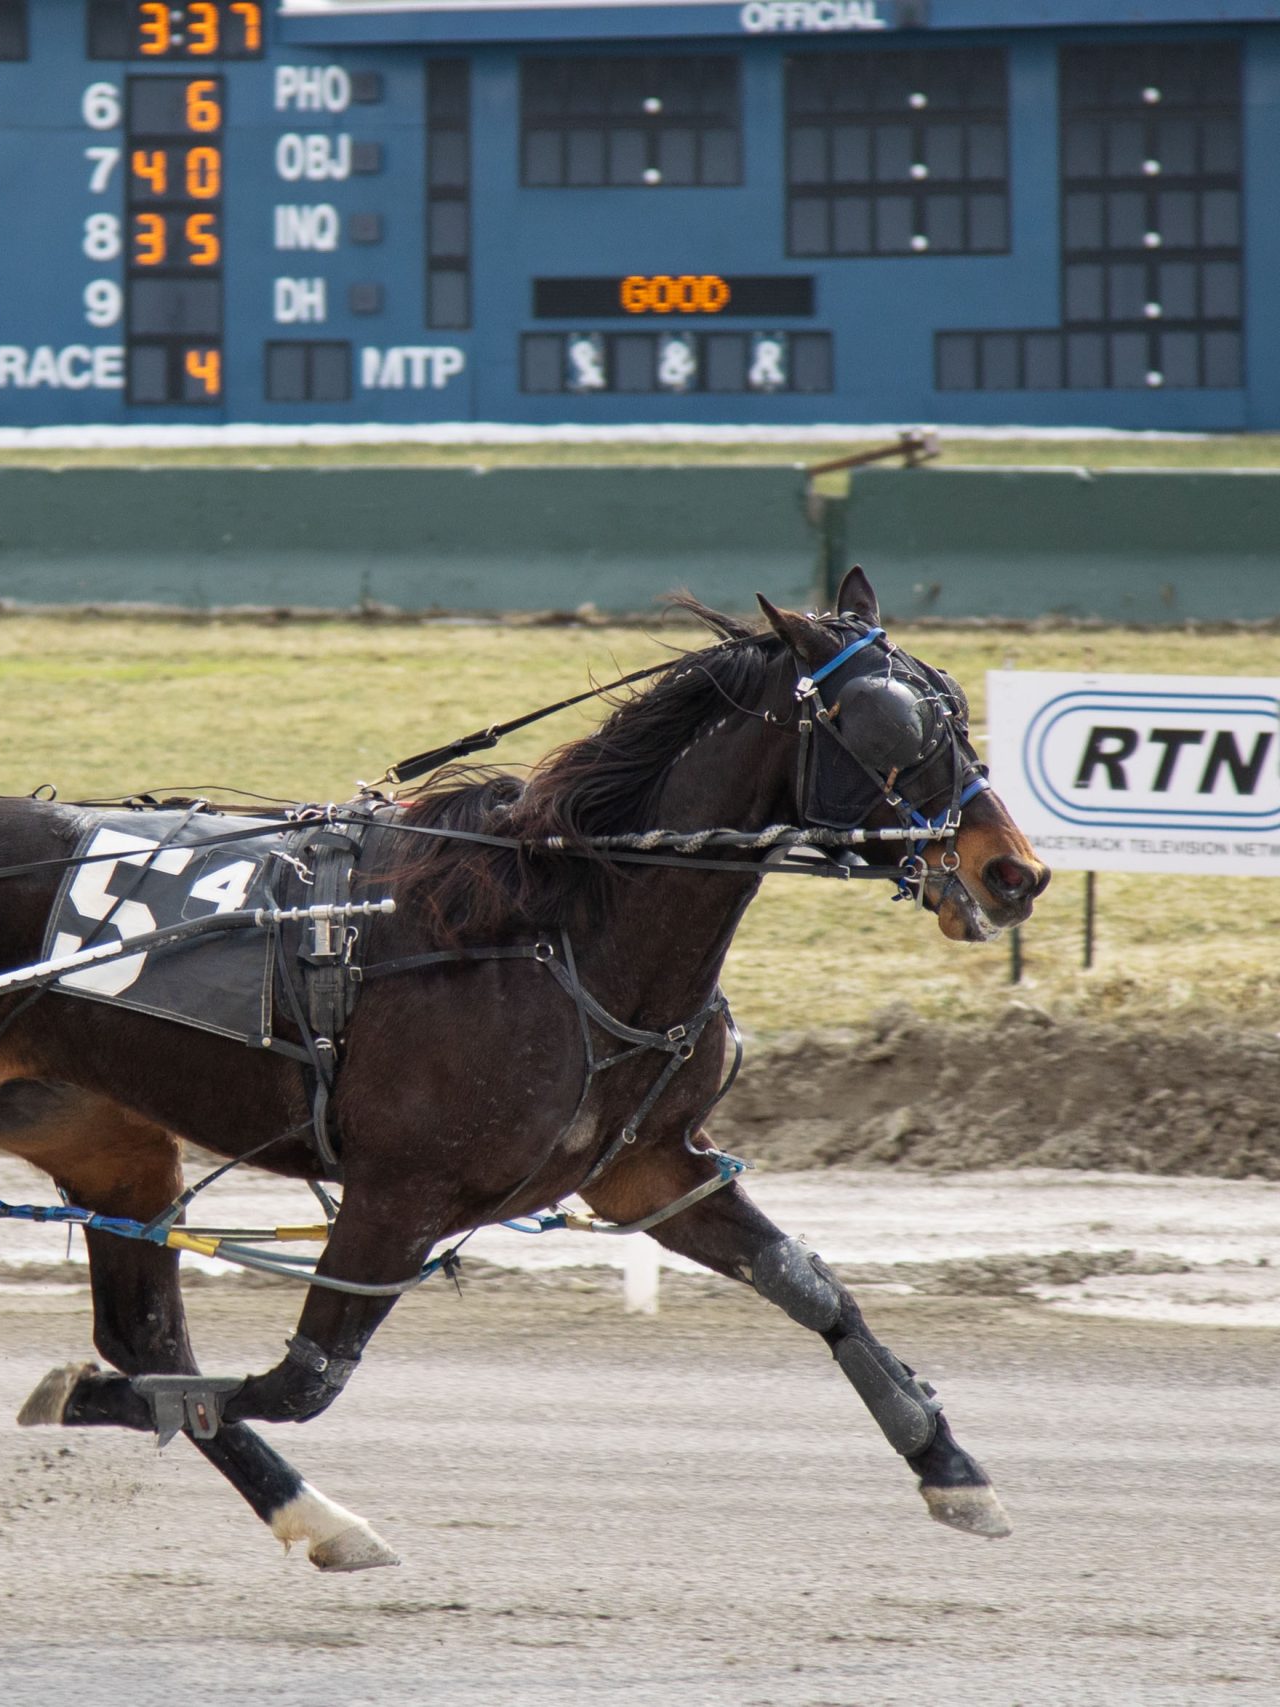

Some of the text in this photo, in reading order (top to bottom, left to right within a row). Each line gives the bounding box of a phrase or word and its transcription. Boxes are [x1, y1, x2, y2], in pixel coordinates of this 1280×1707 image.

[138, 2, 262, 55] 3:37
[740, 0, 888, 33] OFFICIAL
[82, 82, 121, 130] 6
[185, 80, 221, 132] 6
[274, 66, 351, 112] PHO
[83, 147, 120, 194] 7
[131, 146, 221, 200] 40
[276, 133, 352, 180] OBJ
[82, 212, 121, 261] 8
[135, 213, 220, 266] 35
[274, 204, 339, 251] INQ
[83, 278, 122, 327] 9
[273, 277, 326, 323] DH
[185, 350, 221, 394] 4
[361, 346, 465, 390] MTP
[1072, 725, 1274, 796] RTN
[1023, 833, 1124, 854] ACETRACK
[190, 860, 257, 914] 4
[50, 827, 195, 997] 5
